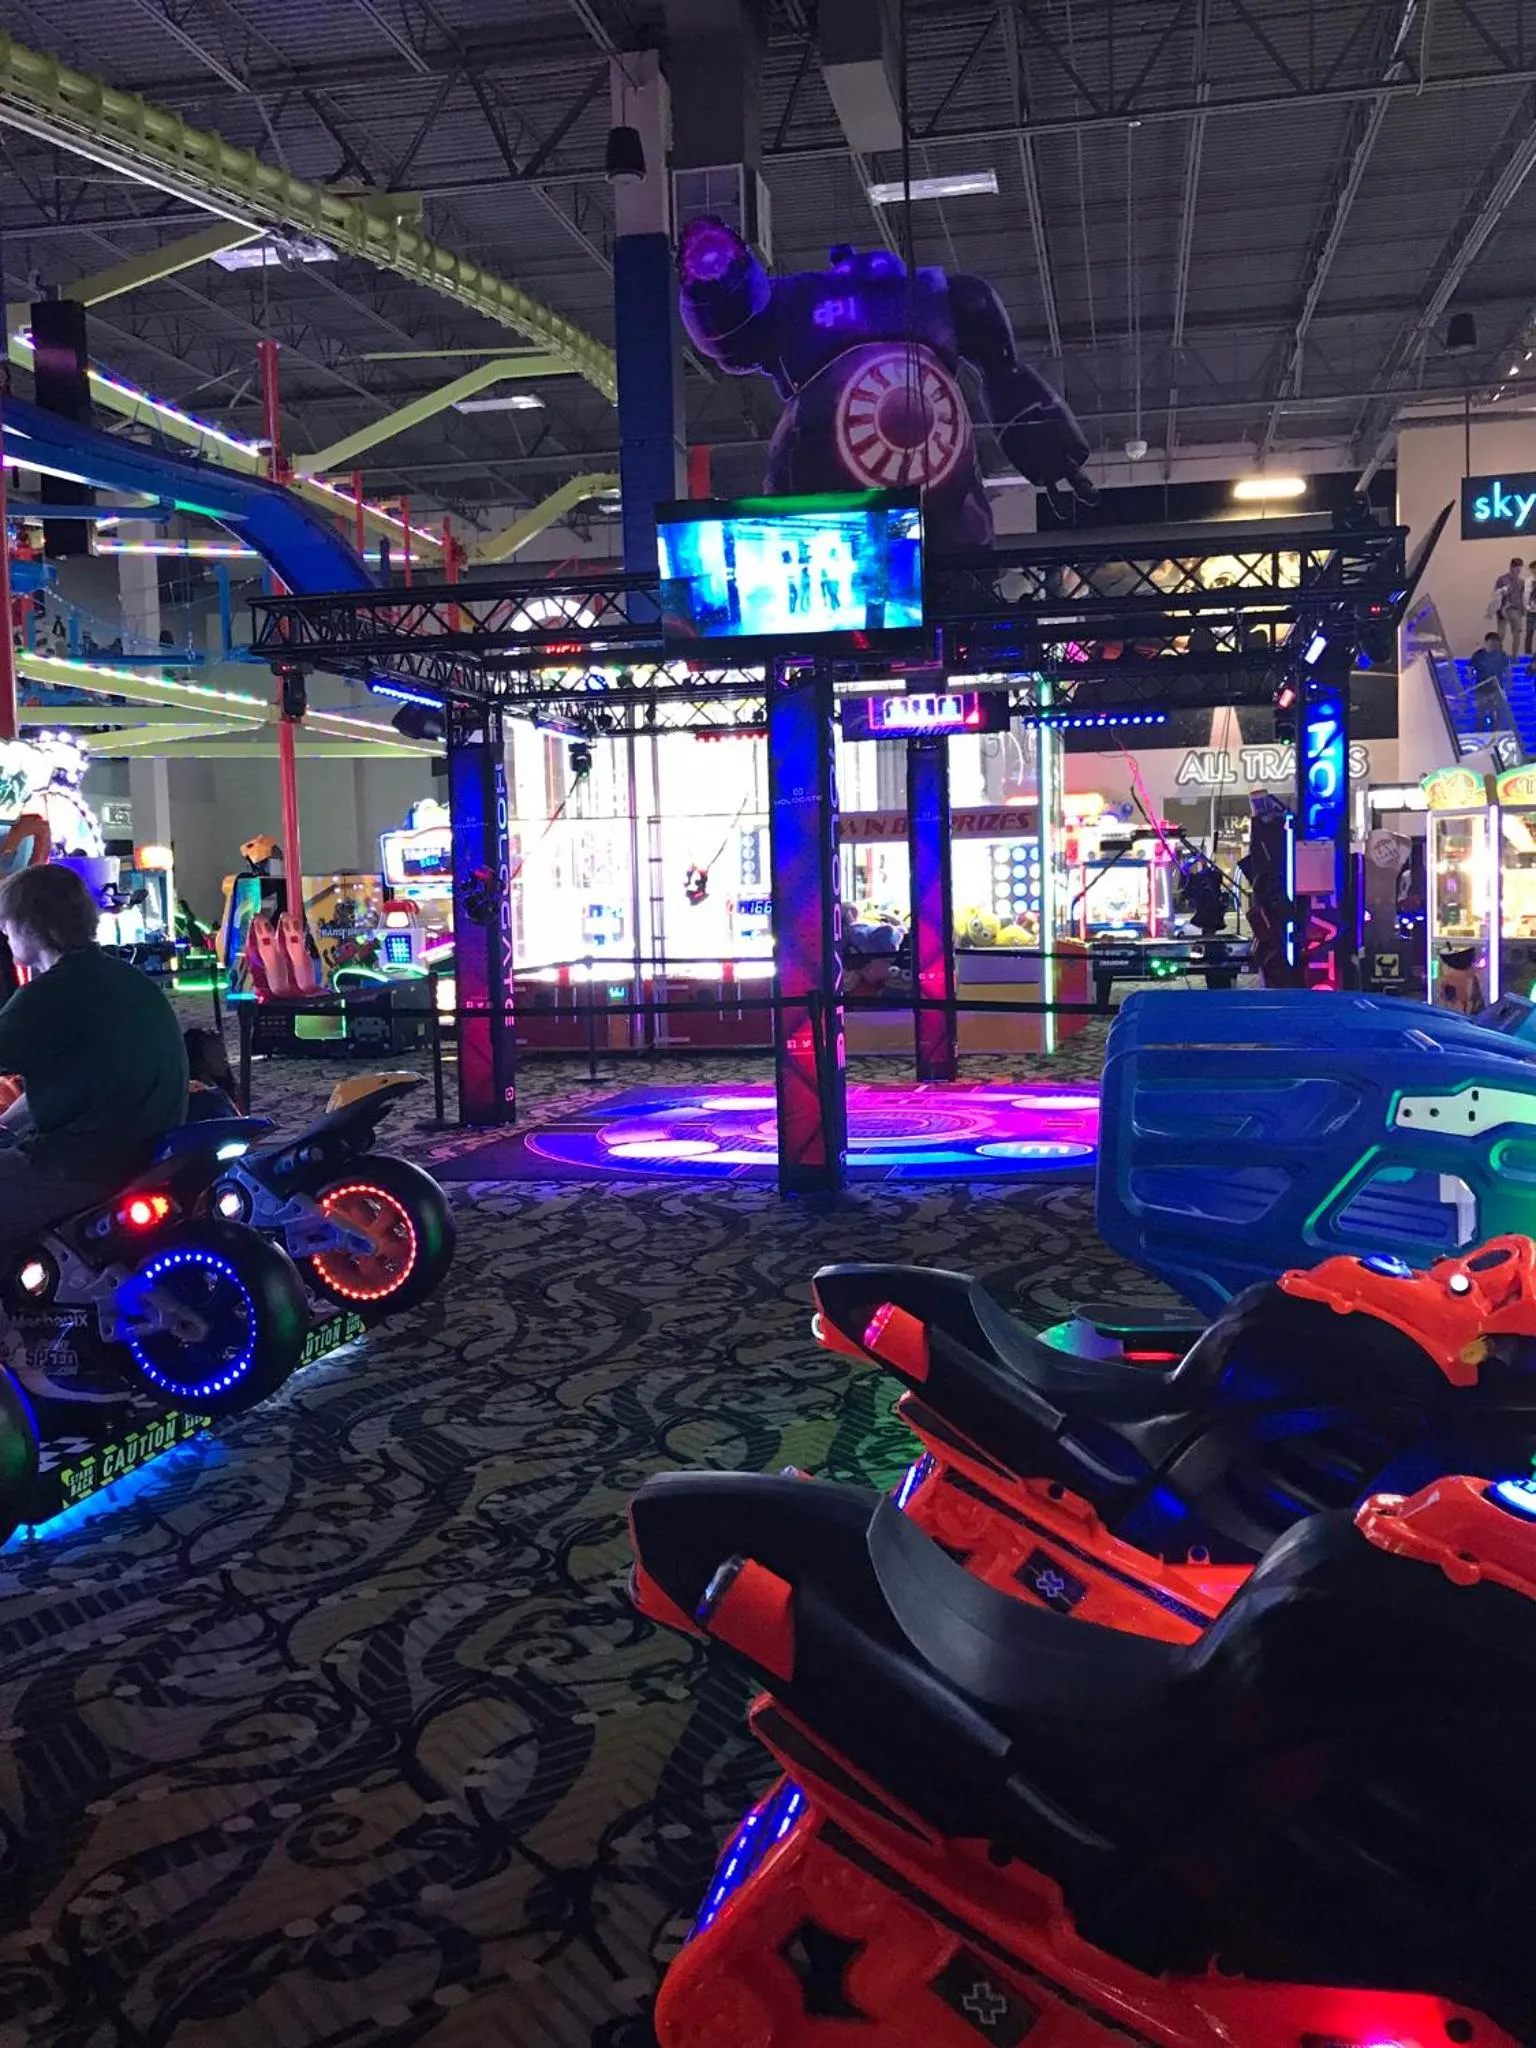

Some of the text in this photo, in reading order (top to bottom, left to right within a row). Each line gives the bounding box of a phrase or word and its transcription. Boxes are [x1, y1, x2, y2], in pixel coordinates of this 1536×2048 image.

[1474, 481, 1536, 528] sky
[1176, 745, 1370, 785] ALL TRAS
[1307, 720, 1338, 990] HOLGAT
[300, 1323, 341, 1361] UTION
[103, 1420, 176, 1477] CAUTION
